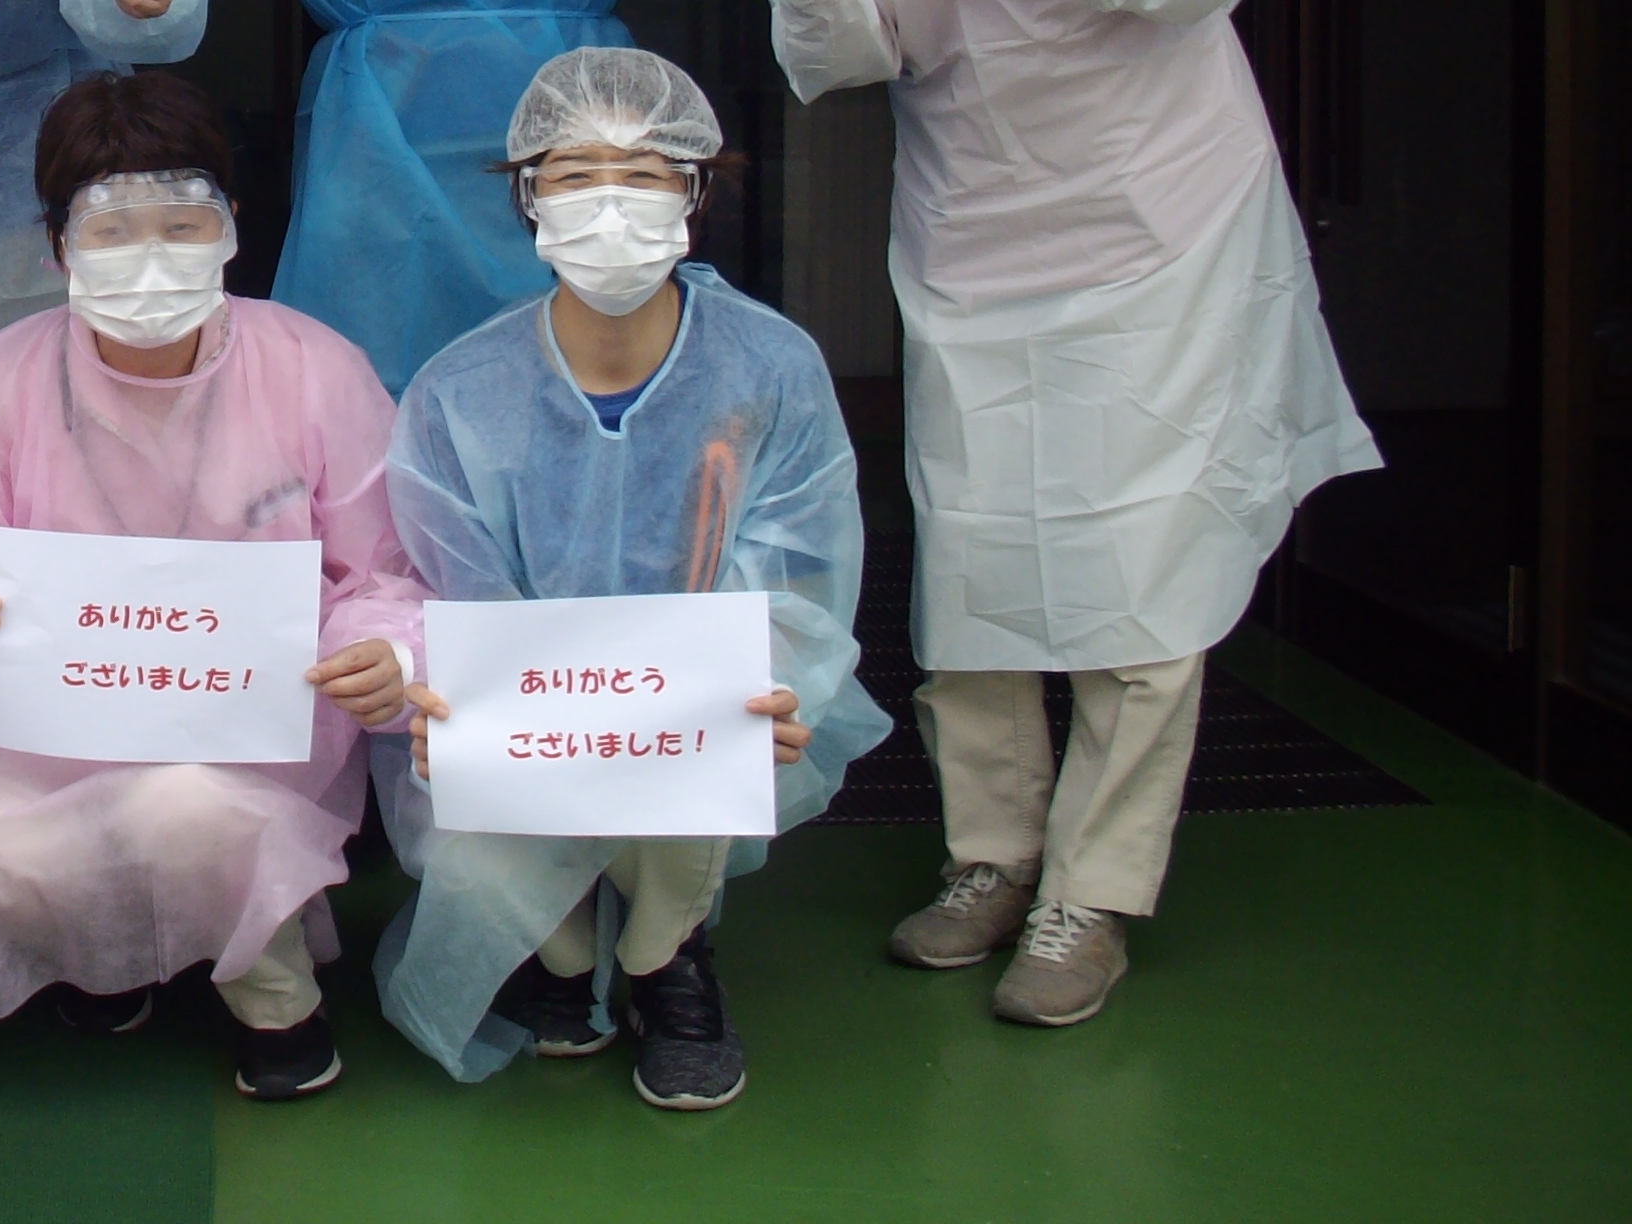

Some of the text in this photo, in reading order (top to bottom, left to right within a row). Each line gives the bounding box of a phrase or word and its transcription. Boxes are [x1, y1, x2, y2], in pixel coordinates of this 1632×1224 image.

[77, 603, 219, 633] ありがとう
[520, 667, 665, 695] ありがとう
